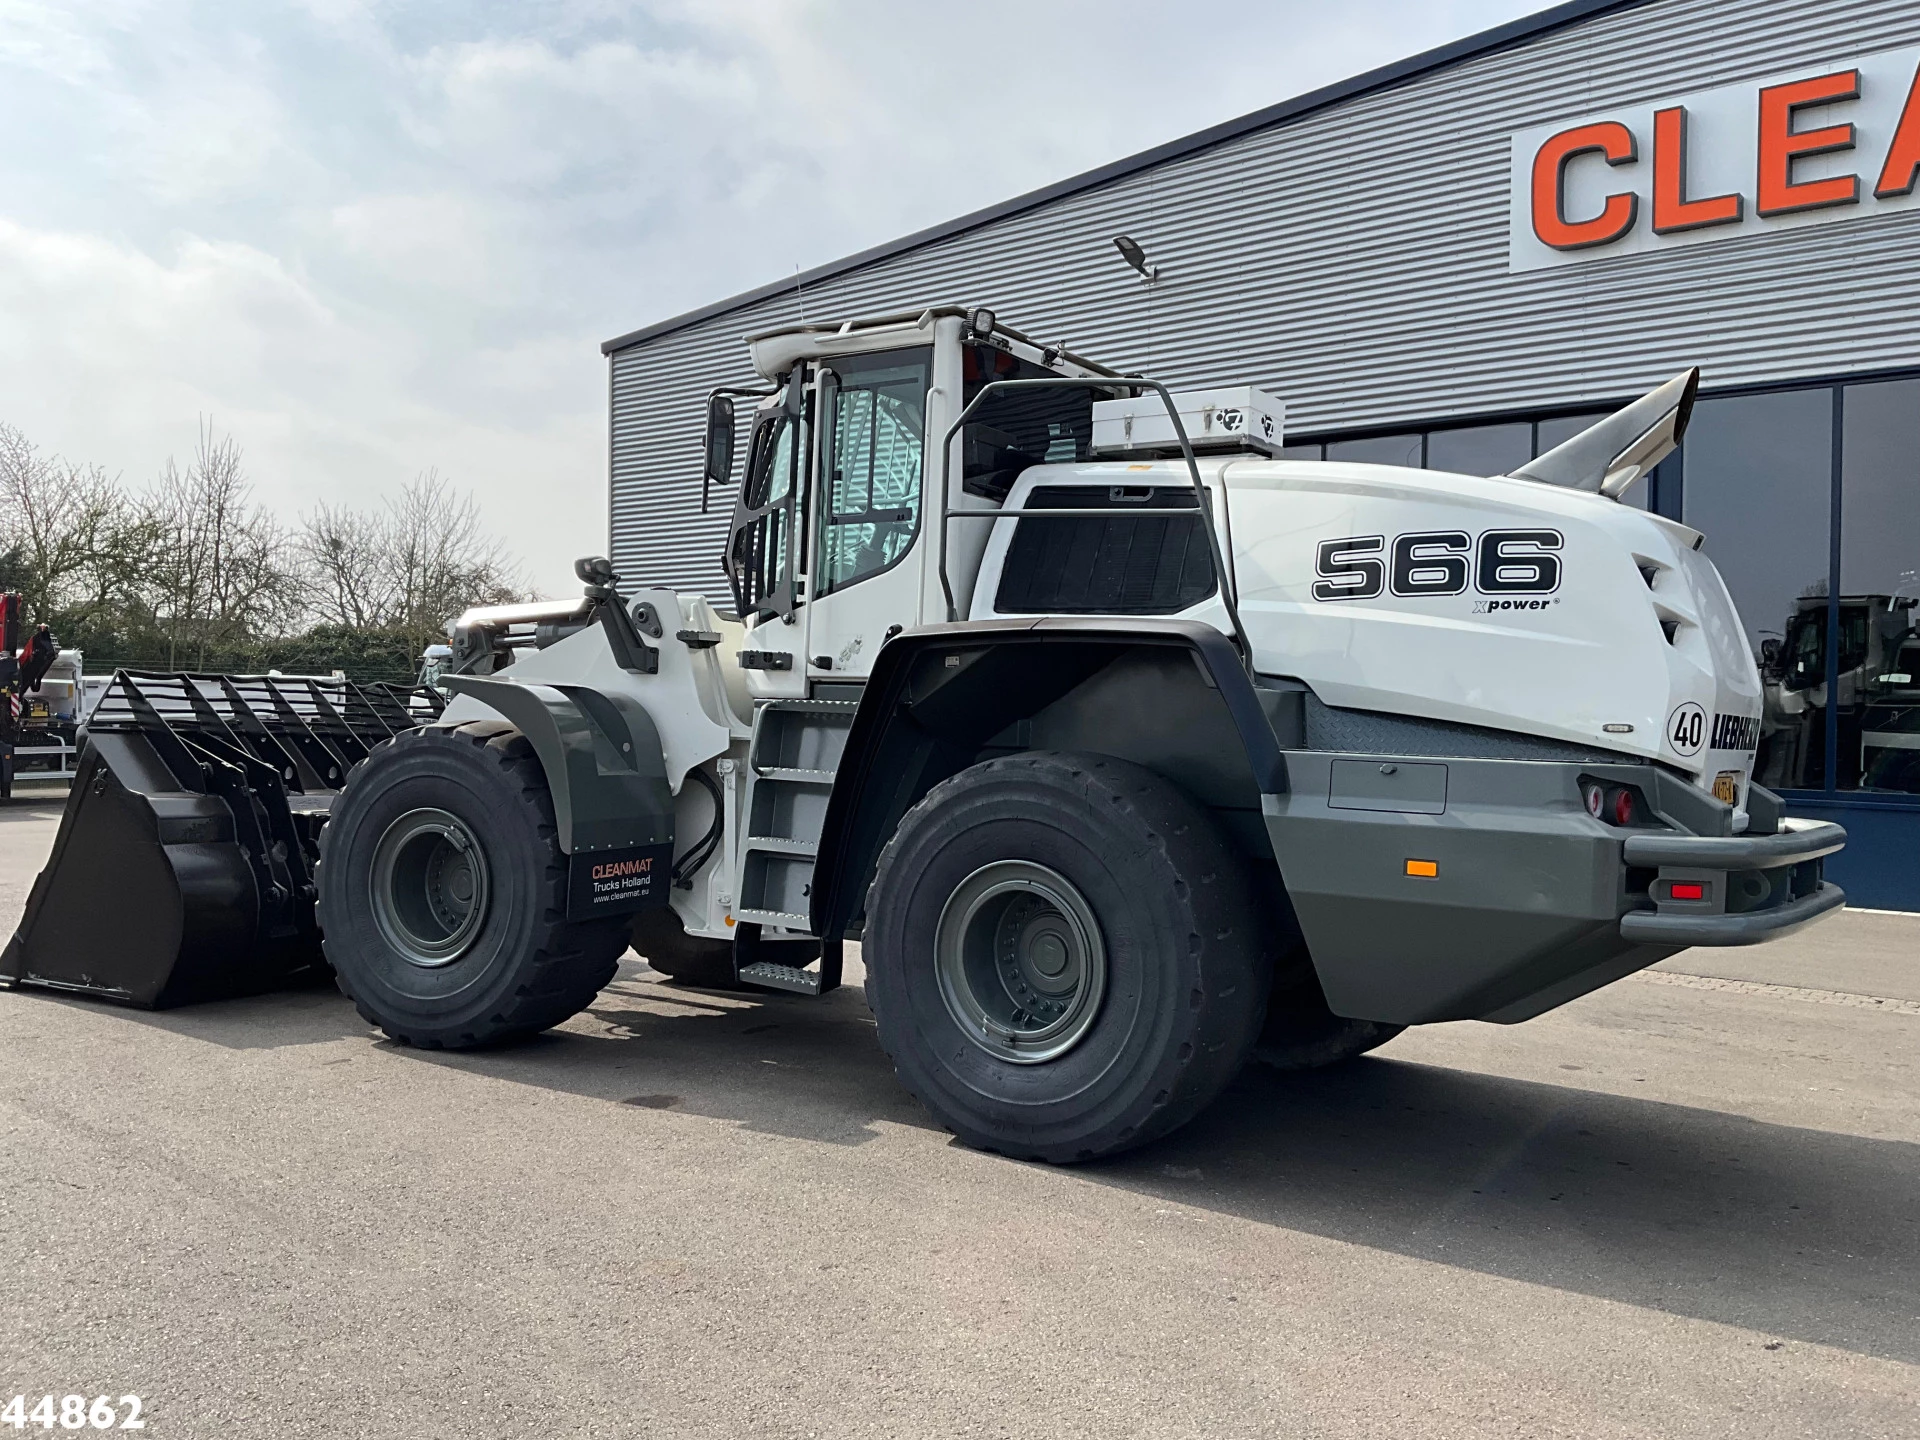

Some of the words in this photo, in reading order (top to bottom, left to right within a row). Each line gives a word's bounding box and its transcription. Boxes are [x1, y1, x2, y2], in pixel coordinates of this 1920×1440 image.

[1311, 528, 1564, 602] 566
[1674, 711, 1702, 747] 40
[592, 858, 653, 880] CLEANMAT
[593, 880, 620, 893] Trucks
[621, 875, 651, 889] Holland
[593, 889, 650, 904] www.cleanmat.eu
